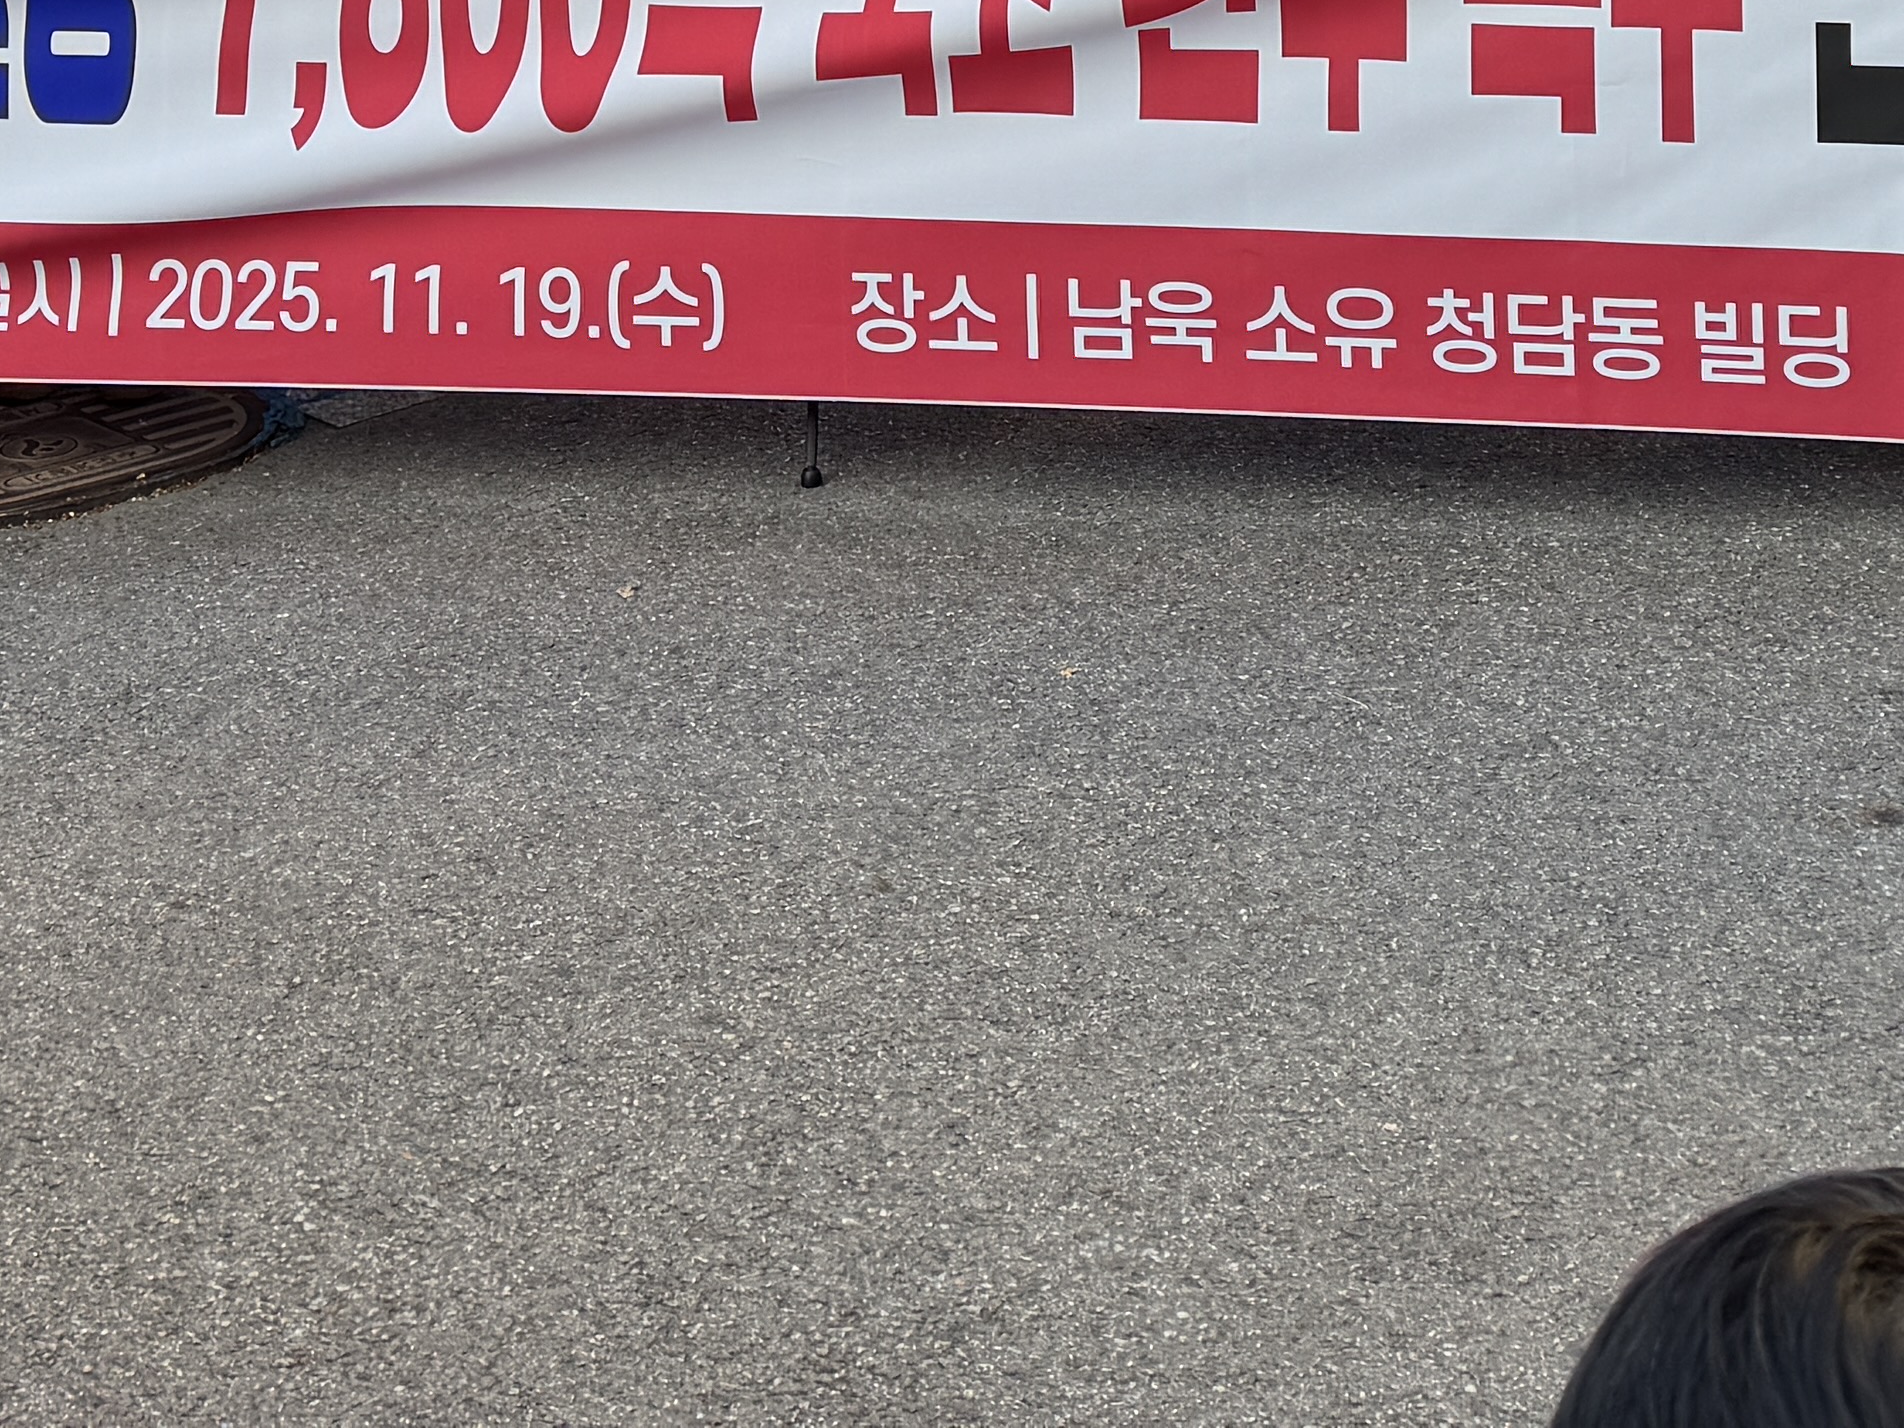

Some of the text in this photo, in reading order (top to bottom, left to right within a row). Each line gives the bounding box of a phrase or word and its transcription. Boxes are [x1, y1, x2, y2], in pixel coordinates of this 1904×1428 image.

[146, 259, 337, 333] 2025.
[369, 263, 468, 336] 11.
[849, 270, 1000, 353] 장소
[1066, 276, 1215, 363] 남욱
[1245, 284, 1400, 370] 소유
[1426, 288, 1663, 381] 청담동
[1693, 300, 1852, 389] 빌딩
